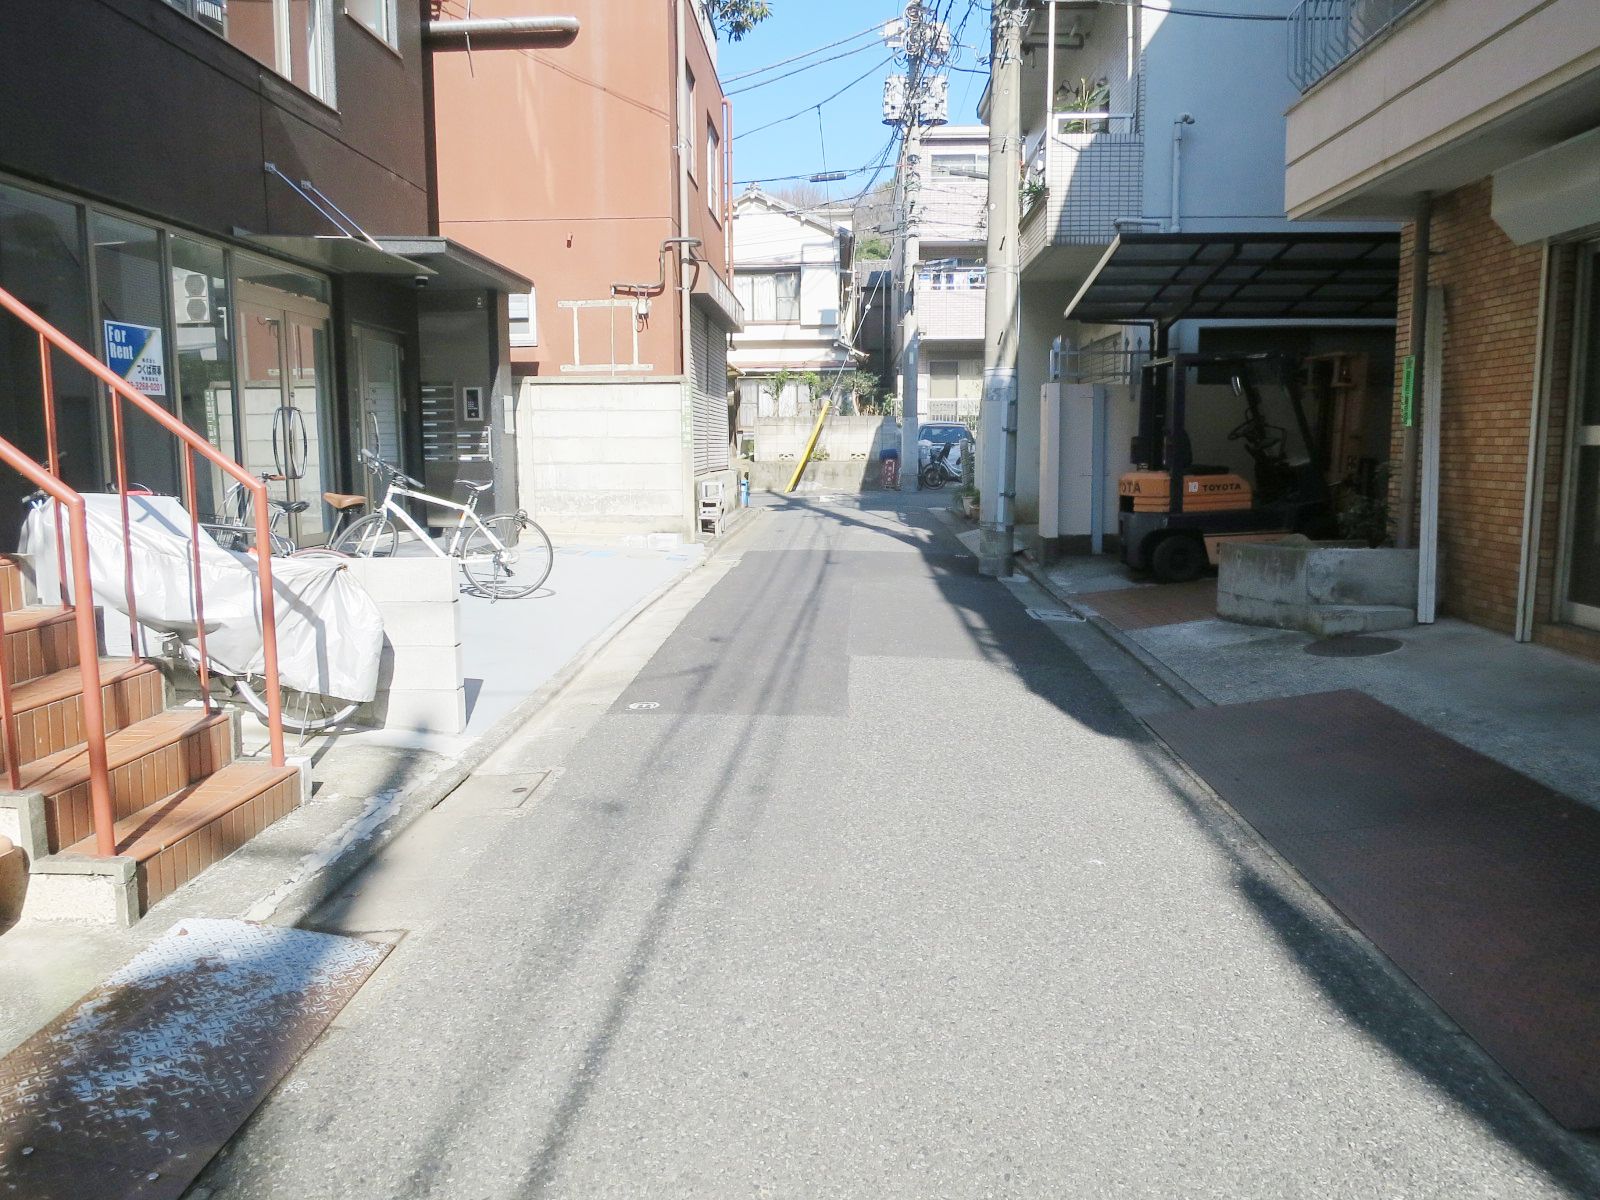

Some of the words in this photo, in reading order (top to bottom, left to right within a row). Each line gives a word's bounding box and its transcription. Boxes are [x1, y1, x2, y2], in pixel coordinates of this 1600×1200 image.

[108, 325, 126, 342] For
[109, 343, 133, 359] Rent
[1202, 483, 1241, 492] TOYOTA
